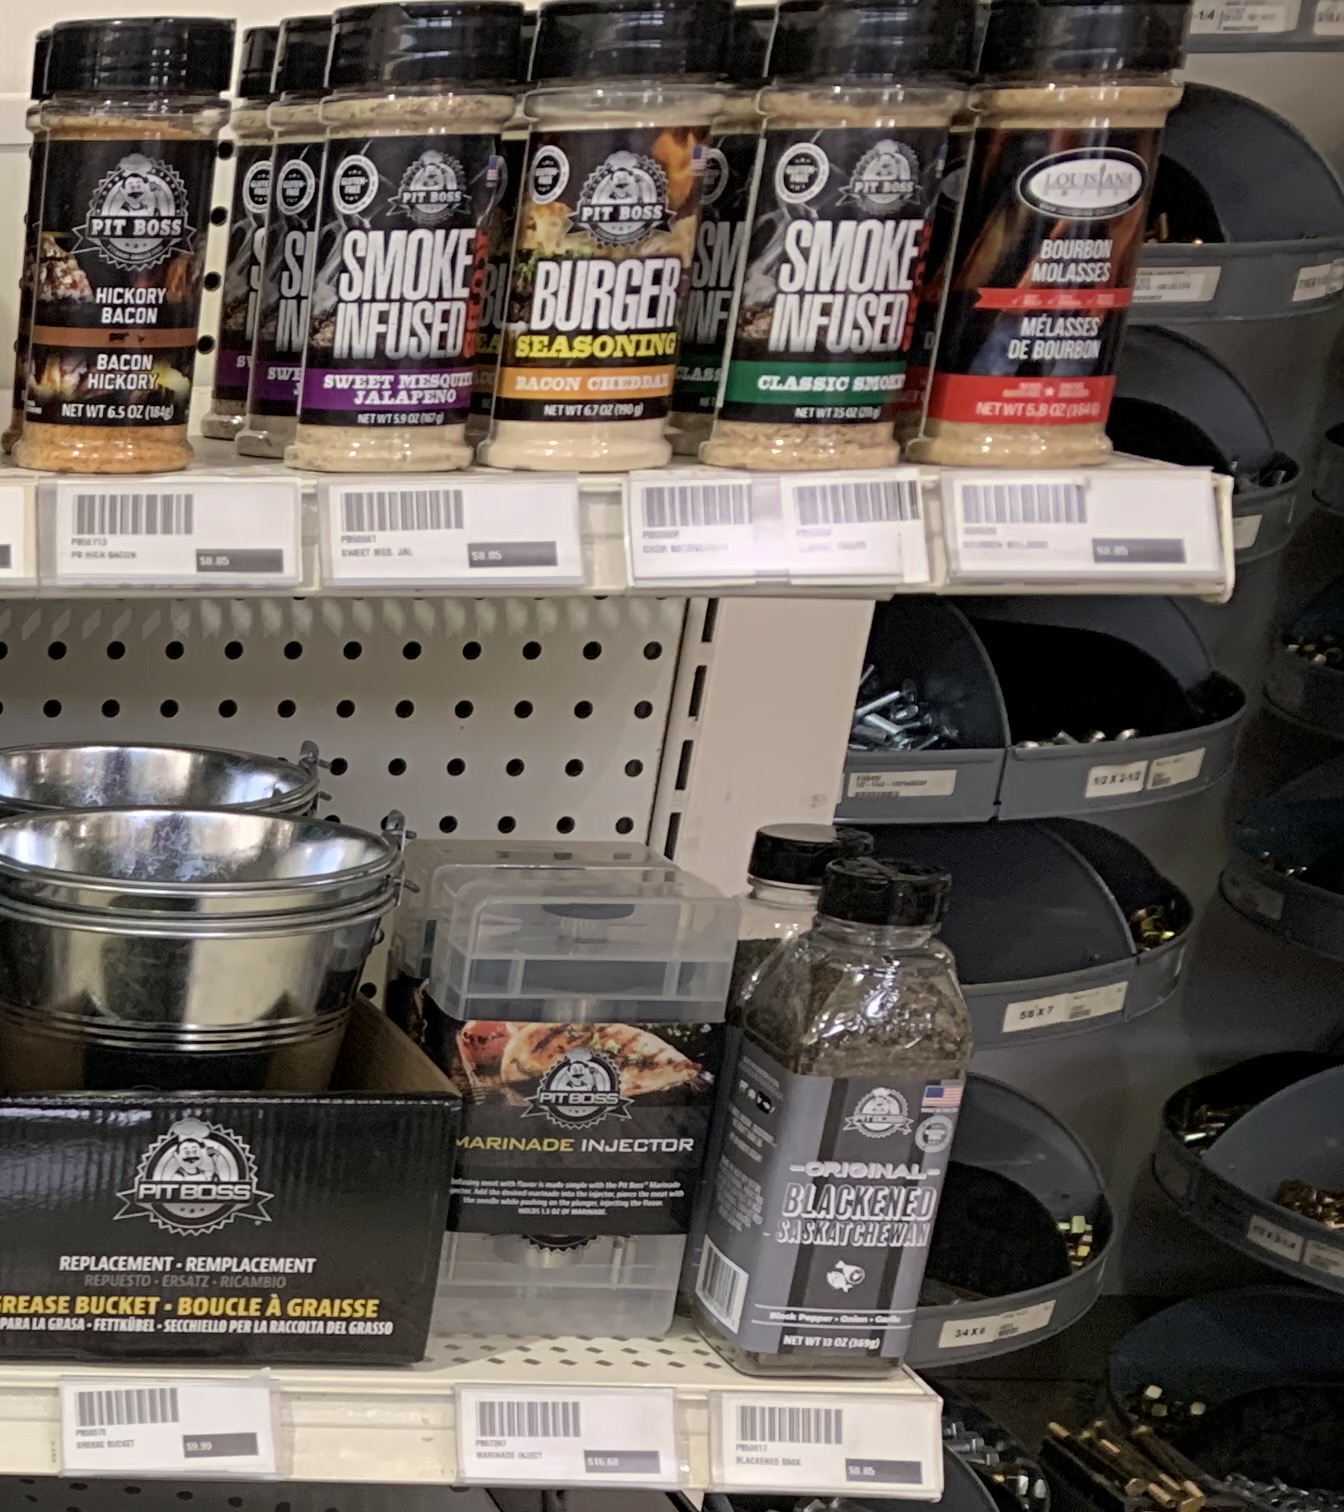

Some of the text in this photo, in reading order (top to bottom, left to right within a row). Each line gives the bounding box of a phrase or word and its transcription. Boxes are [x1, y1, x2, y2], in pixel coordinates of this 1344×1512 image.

[91, 219, 182, 236] PIT BOSS
[779, 219, 924, 293] SMOKE
[1041, 239, 1112, 259] BOURBON
[339, 228, 476, 300] SMOKE
[1032, 262, 1110, 283] MOLASSES
[96, 287, 166, 305] HICKORY
[531, 257, 681, 331] BURGER
[101, 307, 157, 325] BACON
[768, 293, 910, 353] INFUSED
[334, 300, 466, 359] INFUSED
[516, 333, 677, 358] SEASONING
[322, 374, 393, 389] SWEET
[515, 376, 581, 390] BACON
[758, 375, 850, 391] CLASSIC
[455, 1137, 694, 1153] MARINADE INJECTOR
[138, 1183, 251, 1201] PIT BOSS
[783, 1183, 937, 1222] BLACKENED
[777, 1220, 929, 1248] SASKATCHEWAN
[59, 1255, 316, 1273] REPLACEMENT REMPLACEMENT
[75, 1296, 160, 1316] BUCKET
[177, 1297, 265, 1317] BOUCLE
[268, 1293, 282, 1316] À
[287, 1298, 380, 1319] GRAISSE
